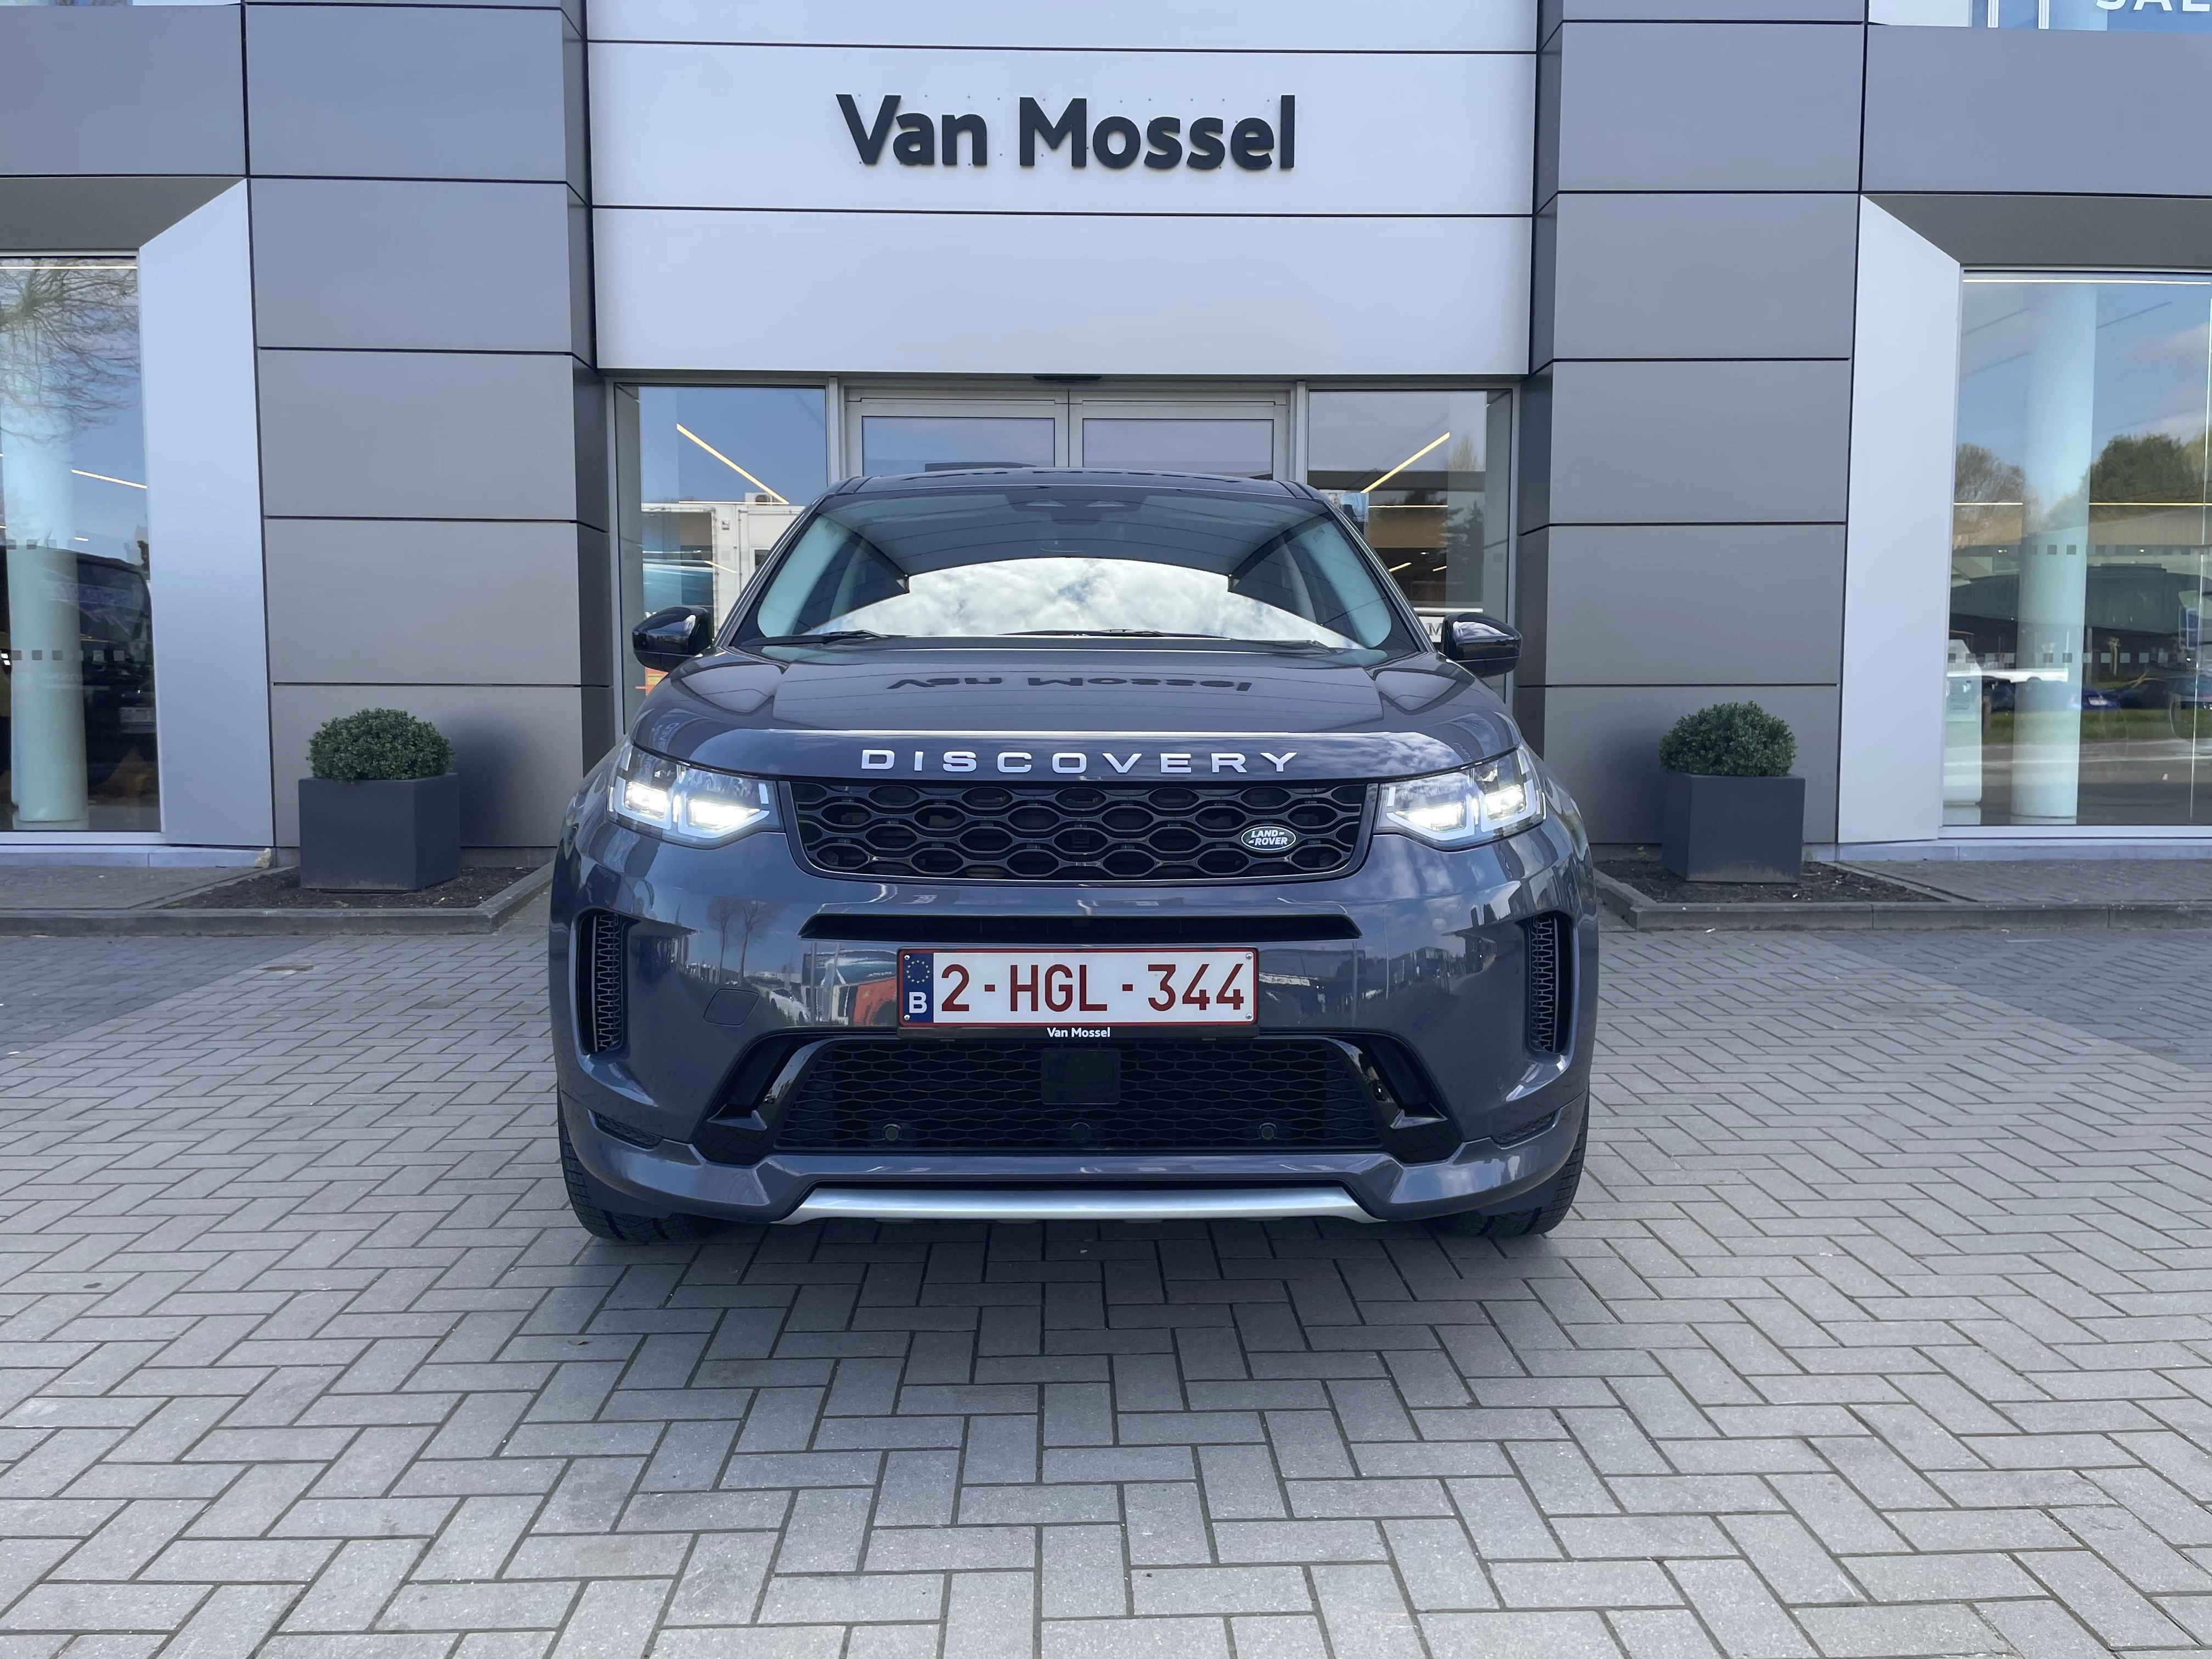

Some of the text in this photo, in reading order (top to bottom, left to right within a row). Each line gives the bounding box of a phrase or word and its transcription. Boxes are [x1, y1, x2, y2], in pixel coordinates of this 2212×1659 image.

[836, 94, 1295, 170] Van Mossel
[861, 749, 1297, 773] DISCOVERY
[1251, 830, 1278, 838] LAND
[1254, 837, 1288, 845] ROVER
[909, 992, 928, 1013] B
[1047, 1026, 1110, 1037] Van Mossel
